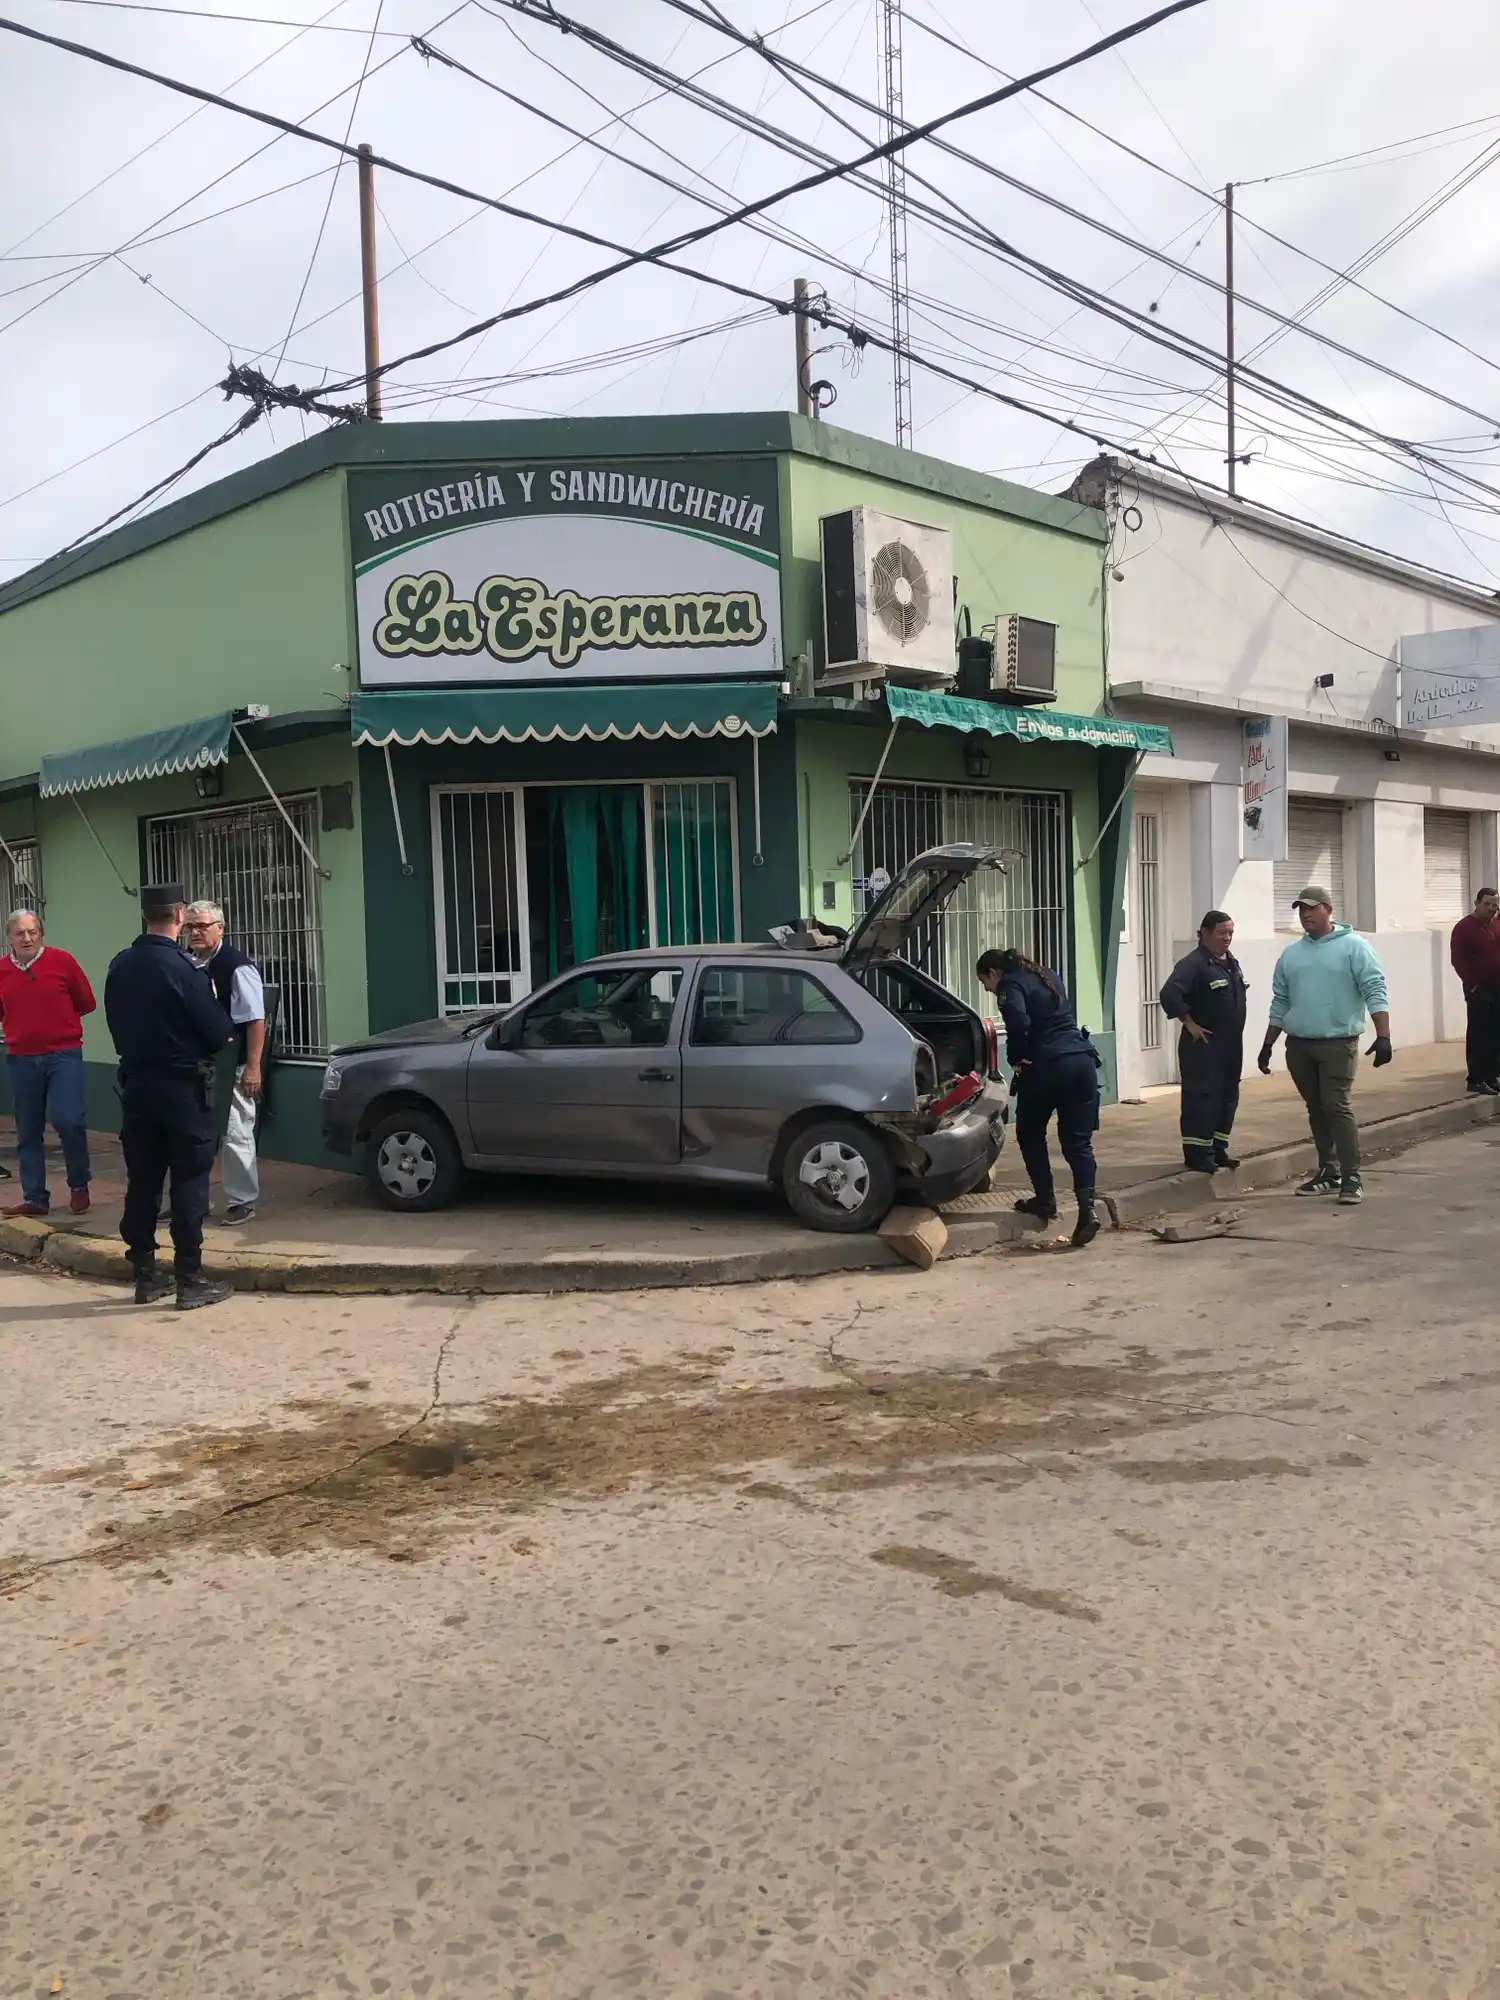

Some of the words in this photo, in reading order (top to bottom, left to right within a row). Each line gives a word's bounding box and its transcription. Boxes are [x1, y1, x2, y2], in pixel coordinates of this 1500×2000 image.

[364, 472, 506, 541] ROTISERÍA
[517, 471, 535, 502] Y
[551, 470, 765, 536] SANDWICHERÍA
[380, 576, 480, 649] La
[481, 579, 760, 662] Esperanza
[1068, 728, 1076, 738] a
[1080, 726, 1136, 744] domicilio
